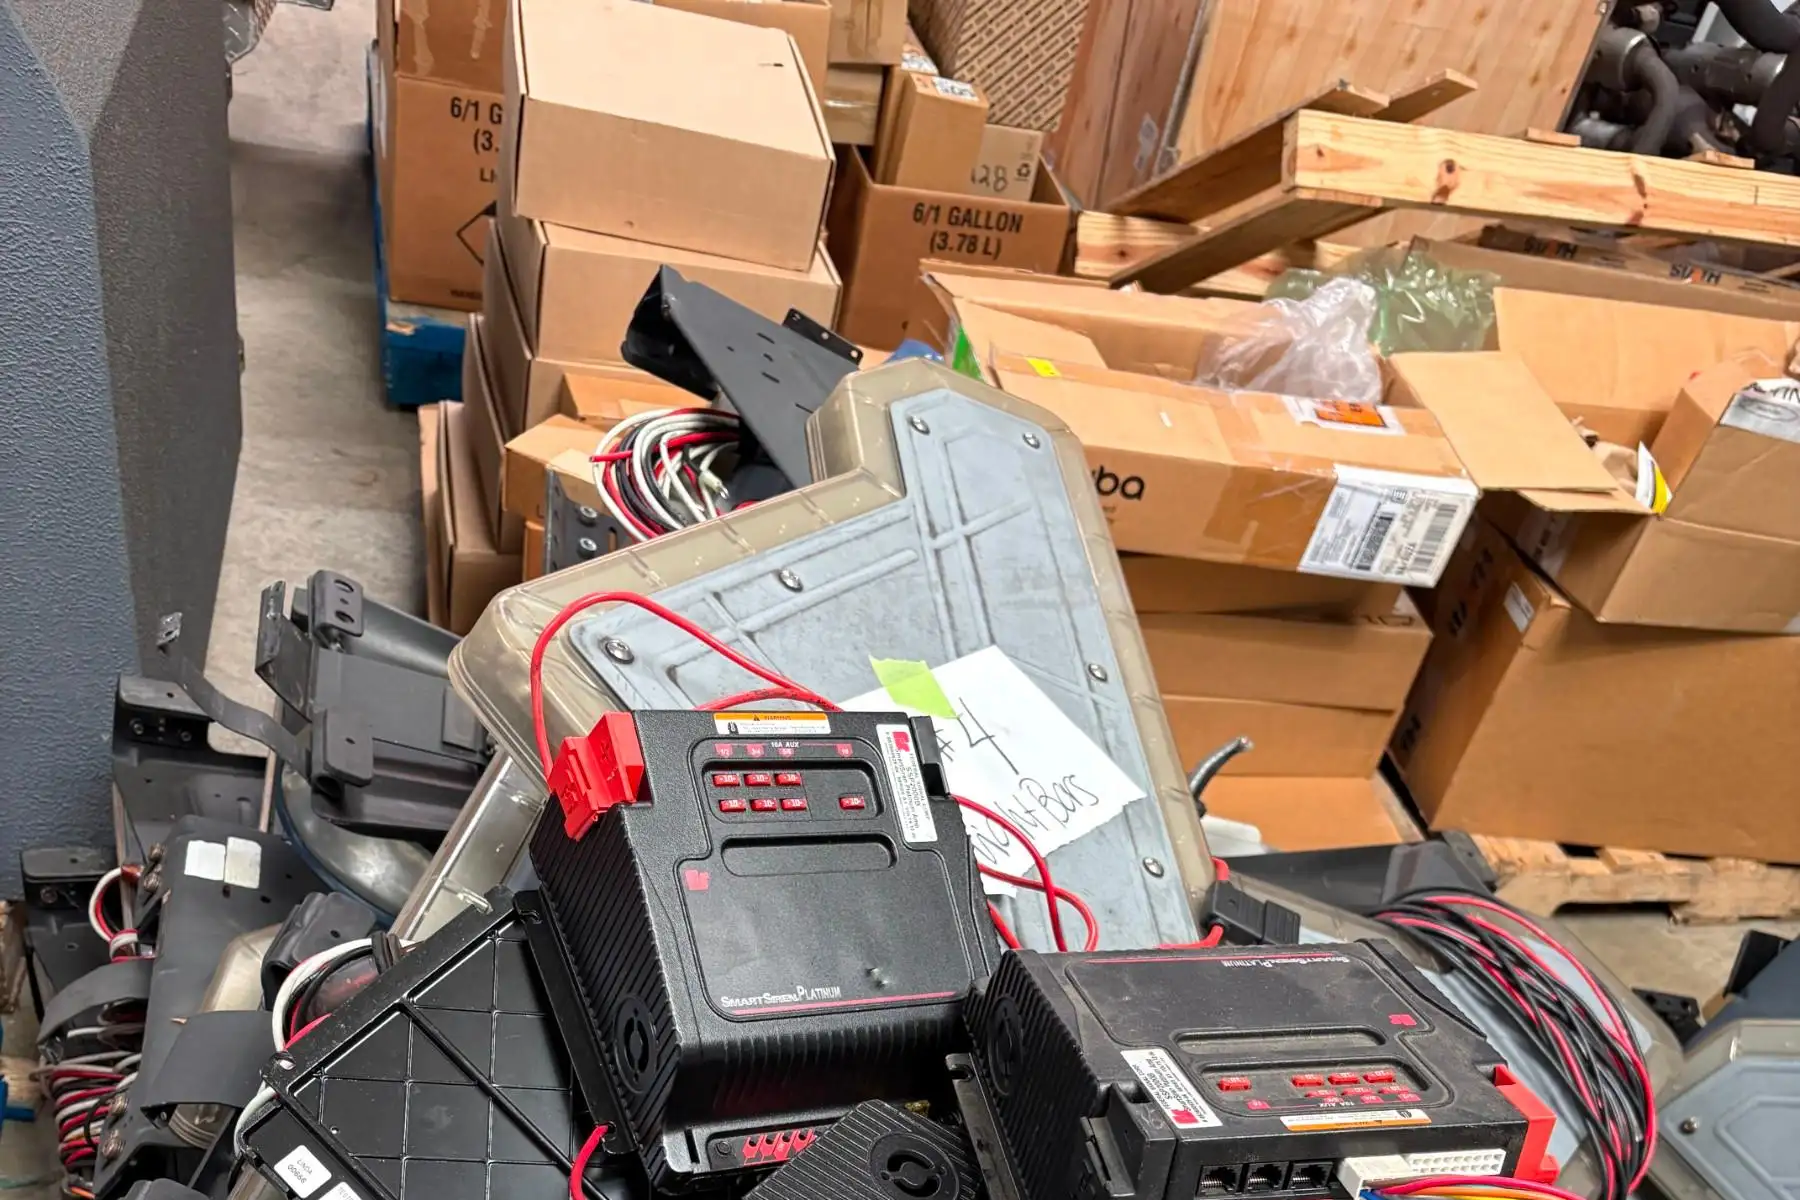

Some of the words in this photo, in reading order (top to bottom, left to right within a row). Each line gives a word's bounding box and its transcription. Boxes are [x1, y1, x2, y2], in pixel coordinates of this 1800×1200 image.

[450, 97, 480, 122] 6/1
[913, 202, 941, 226] 6/1
[948, 206, 1024, 233] GALLON
[930, 231, 978, 254] (3.78
[981, 235, 1003, 260] L)
[1092, 464, 1145, 501] ba
